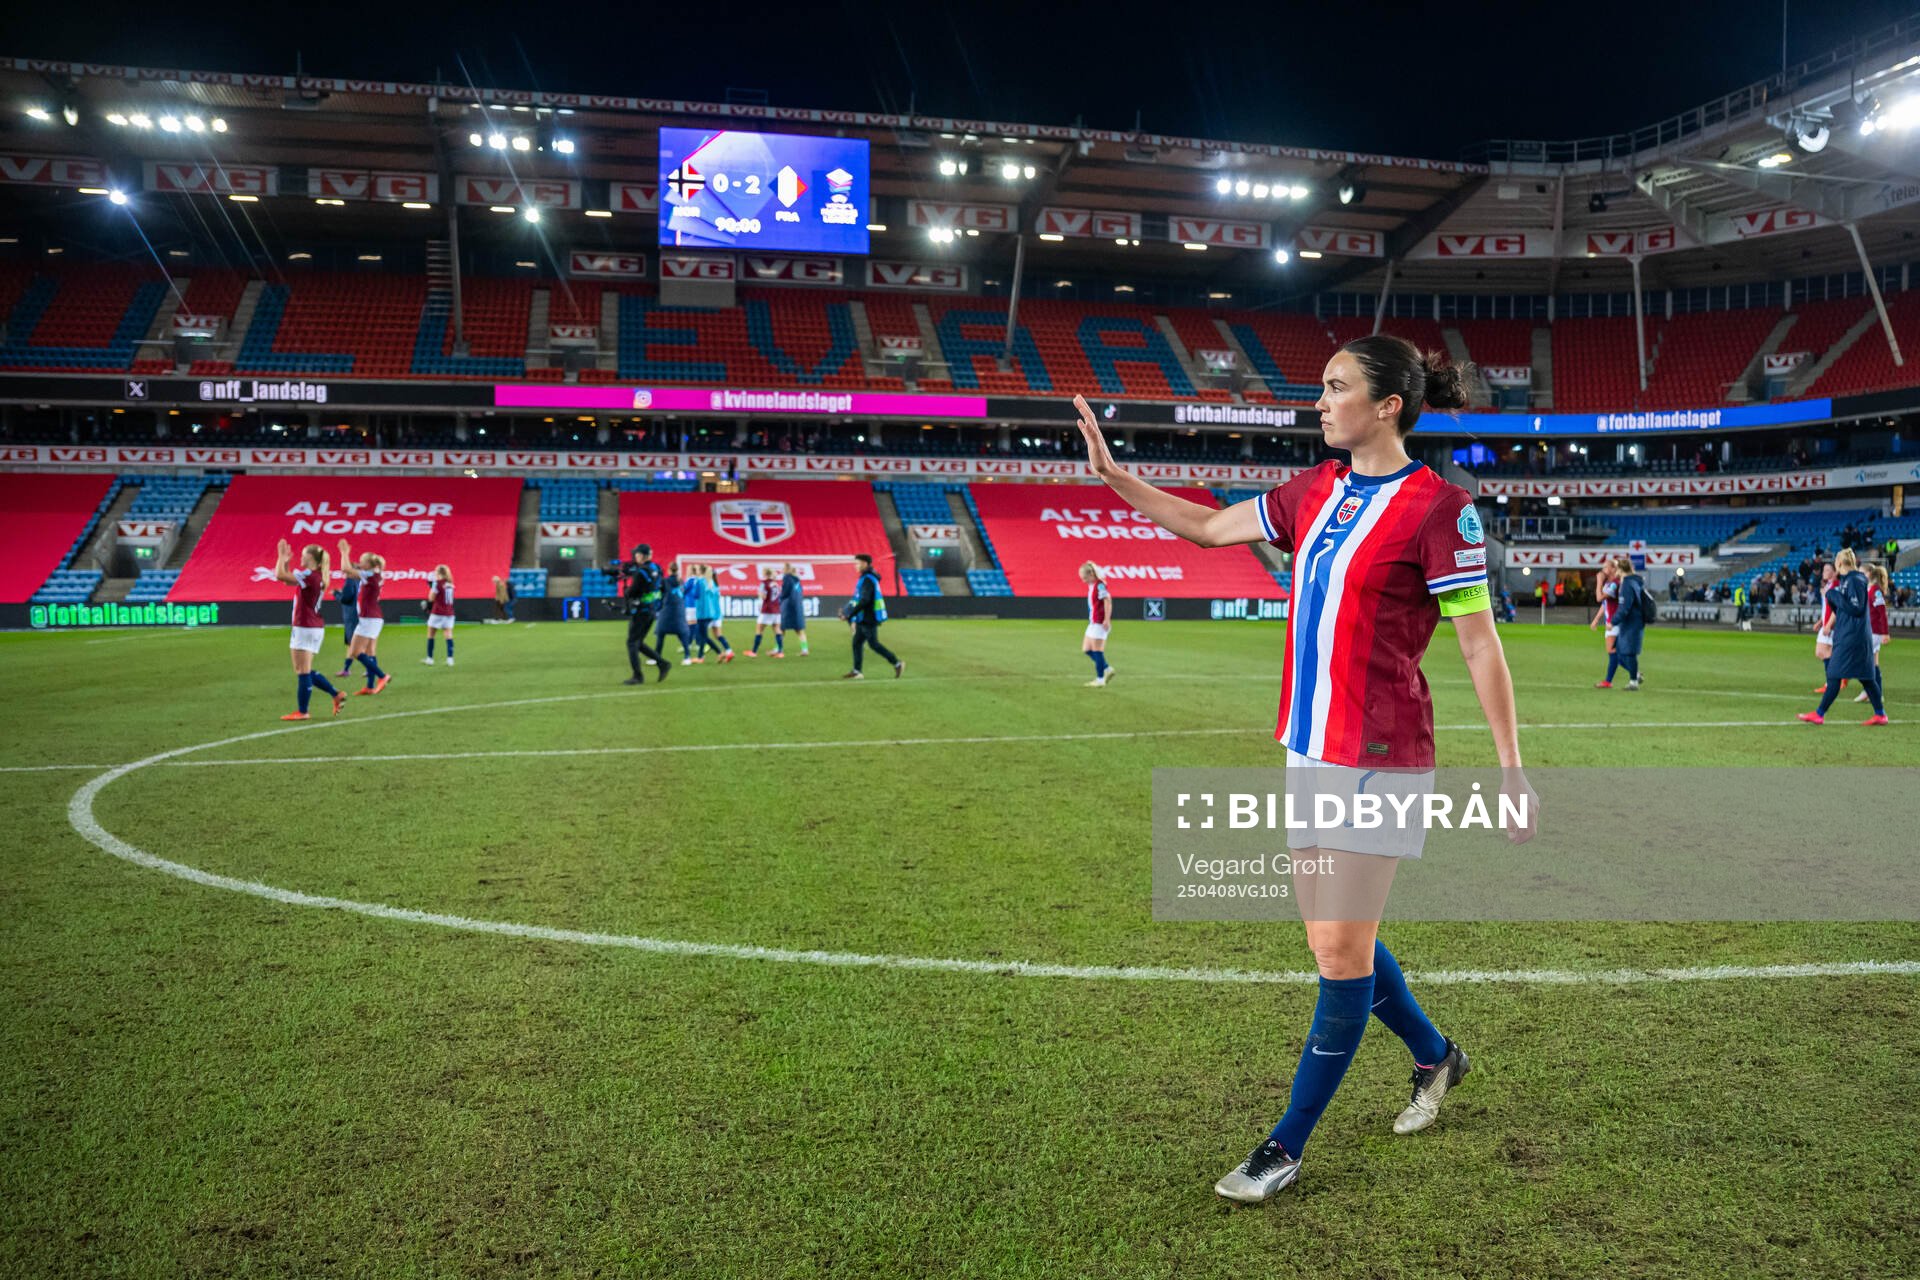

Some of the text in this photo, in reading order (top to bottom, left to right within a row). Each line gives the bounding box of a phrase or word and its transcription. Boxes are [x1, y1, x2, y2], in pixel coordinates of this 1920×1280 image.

[0, 157, 103, 185] VG
[159, 165, 266, 195] VG
[323, 173, 427, 200] VG
[469, 179, 569, 207] VG
[713, 173, 729, 193] 0
[745, 175, 760, 195] 2
[917, 205, 1007, 230] VG
[1047, 211, 1131, 240] VG
[1740, 210, 1815, 236] VG
[1181, 222, 1259, 247] VG
[1299, 230, 1375, 255] VG
[1439, 235, 1524, 256] VG
[1588, 226, 1674, 253] VG
[575, 256, 640, 275] VG
[665, 259, 731, 278] VG
[747, 258, 832, 283] VG
[876, 264, 959, 287] VG
[175, 316, 219, 328] VG
[552, 327, 595, 338] VG
[882, 338, 921, 349] VG
[200, 381, 327, 403] @nff_landslag
[711, 391, 852, 413] @kvinnelandslaget
[1175, 405, 1297, 427] @fotballandslaget
[1597, 409, 1722, 432] @fotballandslaget
[51, 449, 107, 461] VG
[120, 450, 174, 462] VG
[187, 451, 240, 463] VG
[252, 452, 305, 463] VG
[317, 452, 370, 464] VG
[382, 453, 433, 464] VG
[446, 453, 495, 465] VG
[508, 454, 557, 466] VG
[569, 454, 618, 466] VG
[630, 455, 678, 467] VG
[749, 457, 796, 469] VG
[807, 458, 853, 470] VG
[865, 459, 910, 471] VG
[922, 460, 966, 472] VG
[977, 461, 1020, 473] VG
[1032, 462, 1075, 474] VG
[1138, 465, 1180, 477] VG
[1190, 466, 1231, 478] VG
[1241, 467, 1281, 479] VG
[1482, 475, 1825, 495] VG VG VG VG VG VG VG
[285, 501, 454, 517] ALT FOR
[1040, 508, 1102, 522] ALT
[292, 519, 435, 535] NORGE
[542, 525, 593, 537] VG
[914, 527, 959, 539] VG
[1057, 524, 1178, 541] NORGE
[1308, 538, 1335, 584] 7
[1514, 552, 1563, 564] VG
[1646, 552, 1693, 564] VG
[1097, 566, 1157, 580] KIWI
[31, 602, 219, 629] @fotballandslaget
